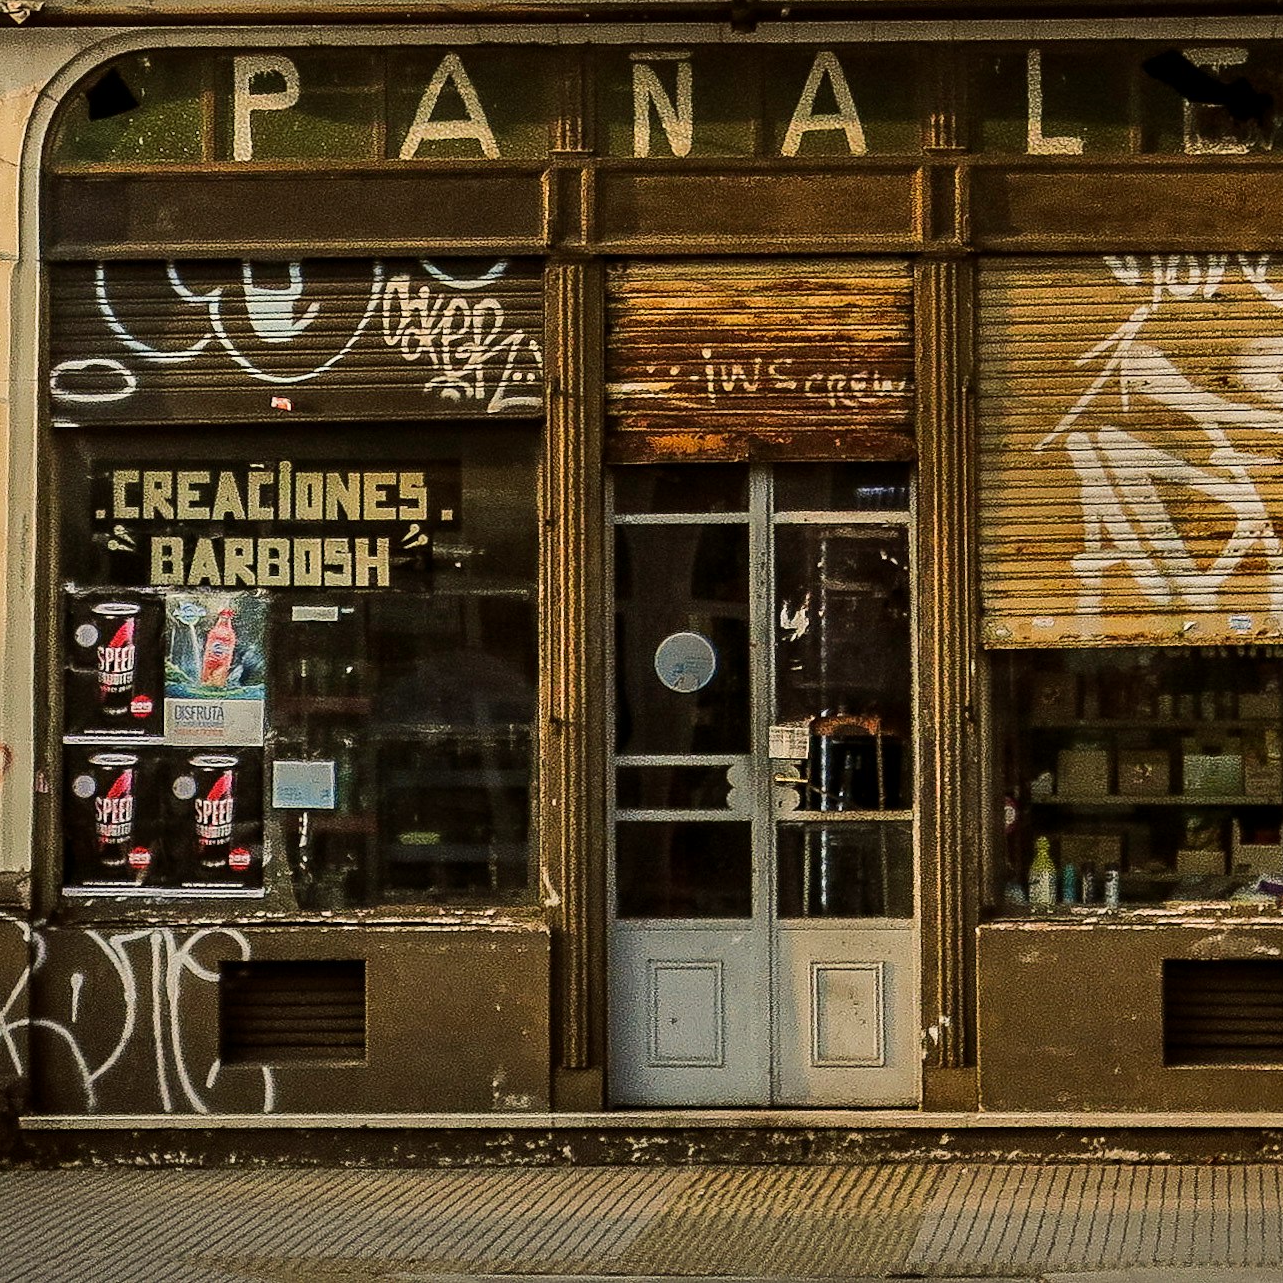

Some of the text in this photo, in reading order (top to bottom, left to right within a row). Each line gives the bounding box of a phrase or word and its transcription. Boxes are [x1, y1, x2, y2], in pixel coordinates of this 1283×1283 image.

[149, 536, 391, 587] BARBOSH
[97, 646, 136, 672] SPEED
[174, 704, 225, 720] DISFRUTA
[95, 796, 134, 824] SPEED
[194, 798, 234, 826] SPEED
